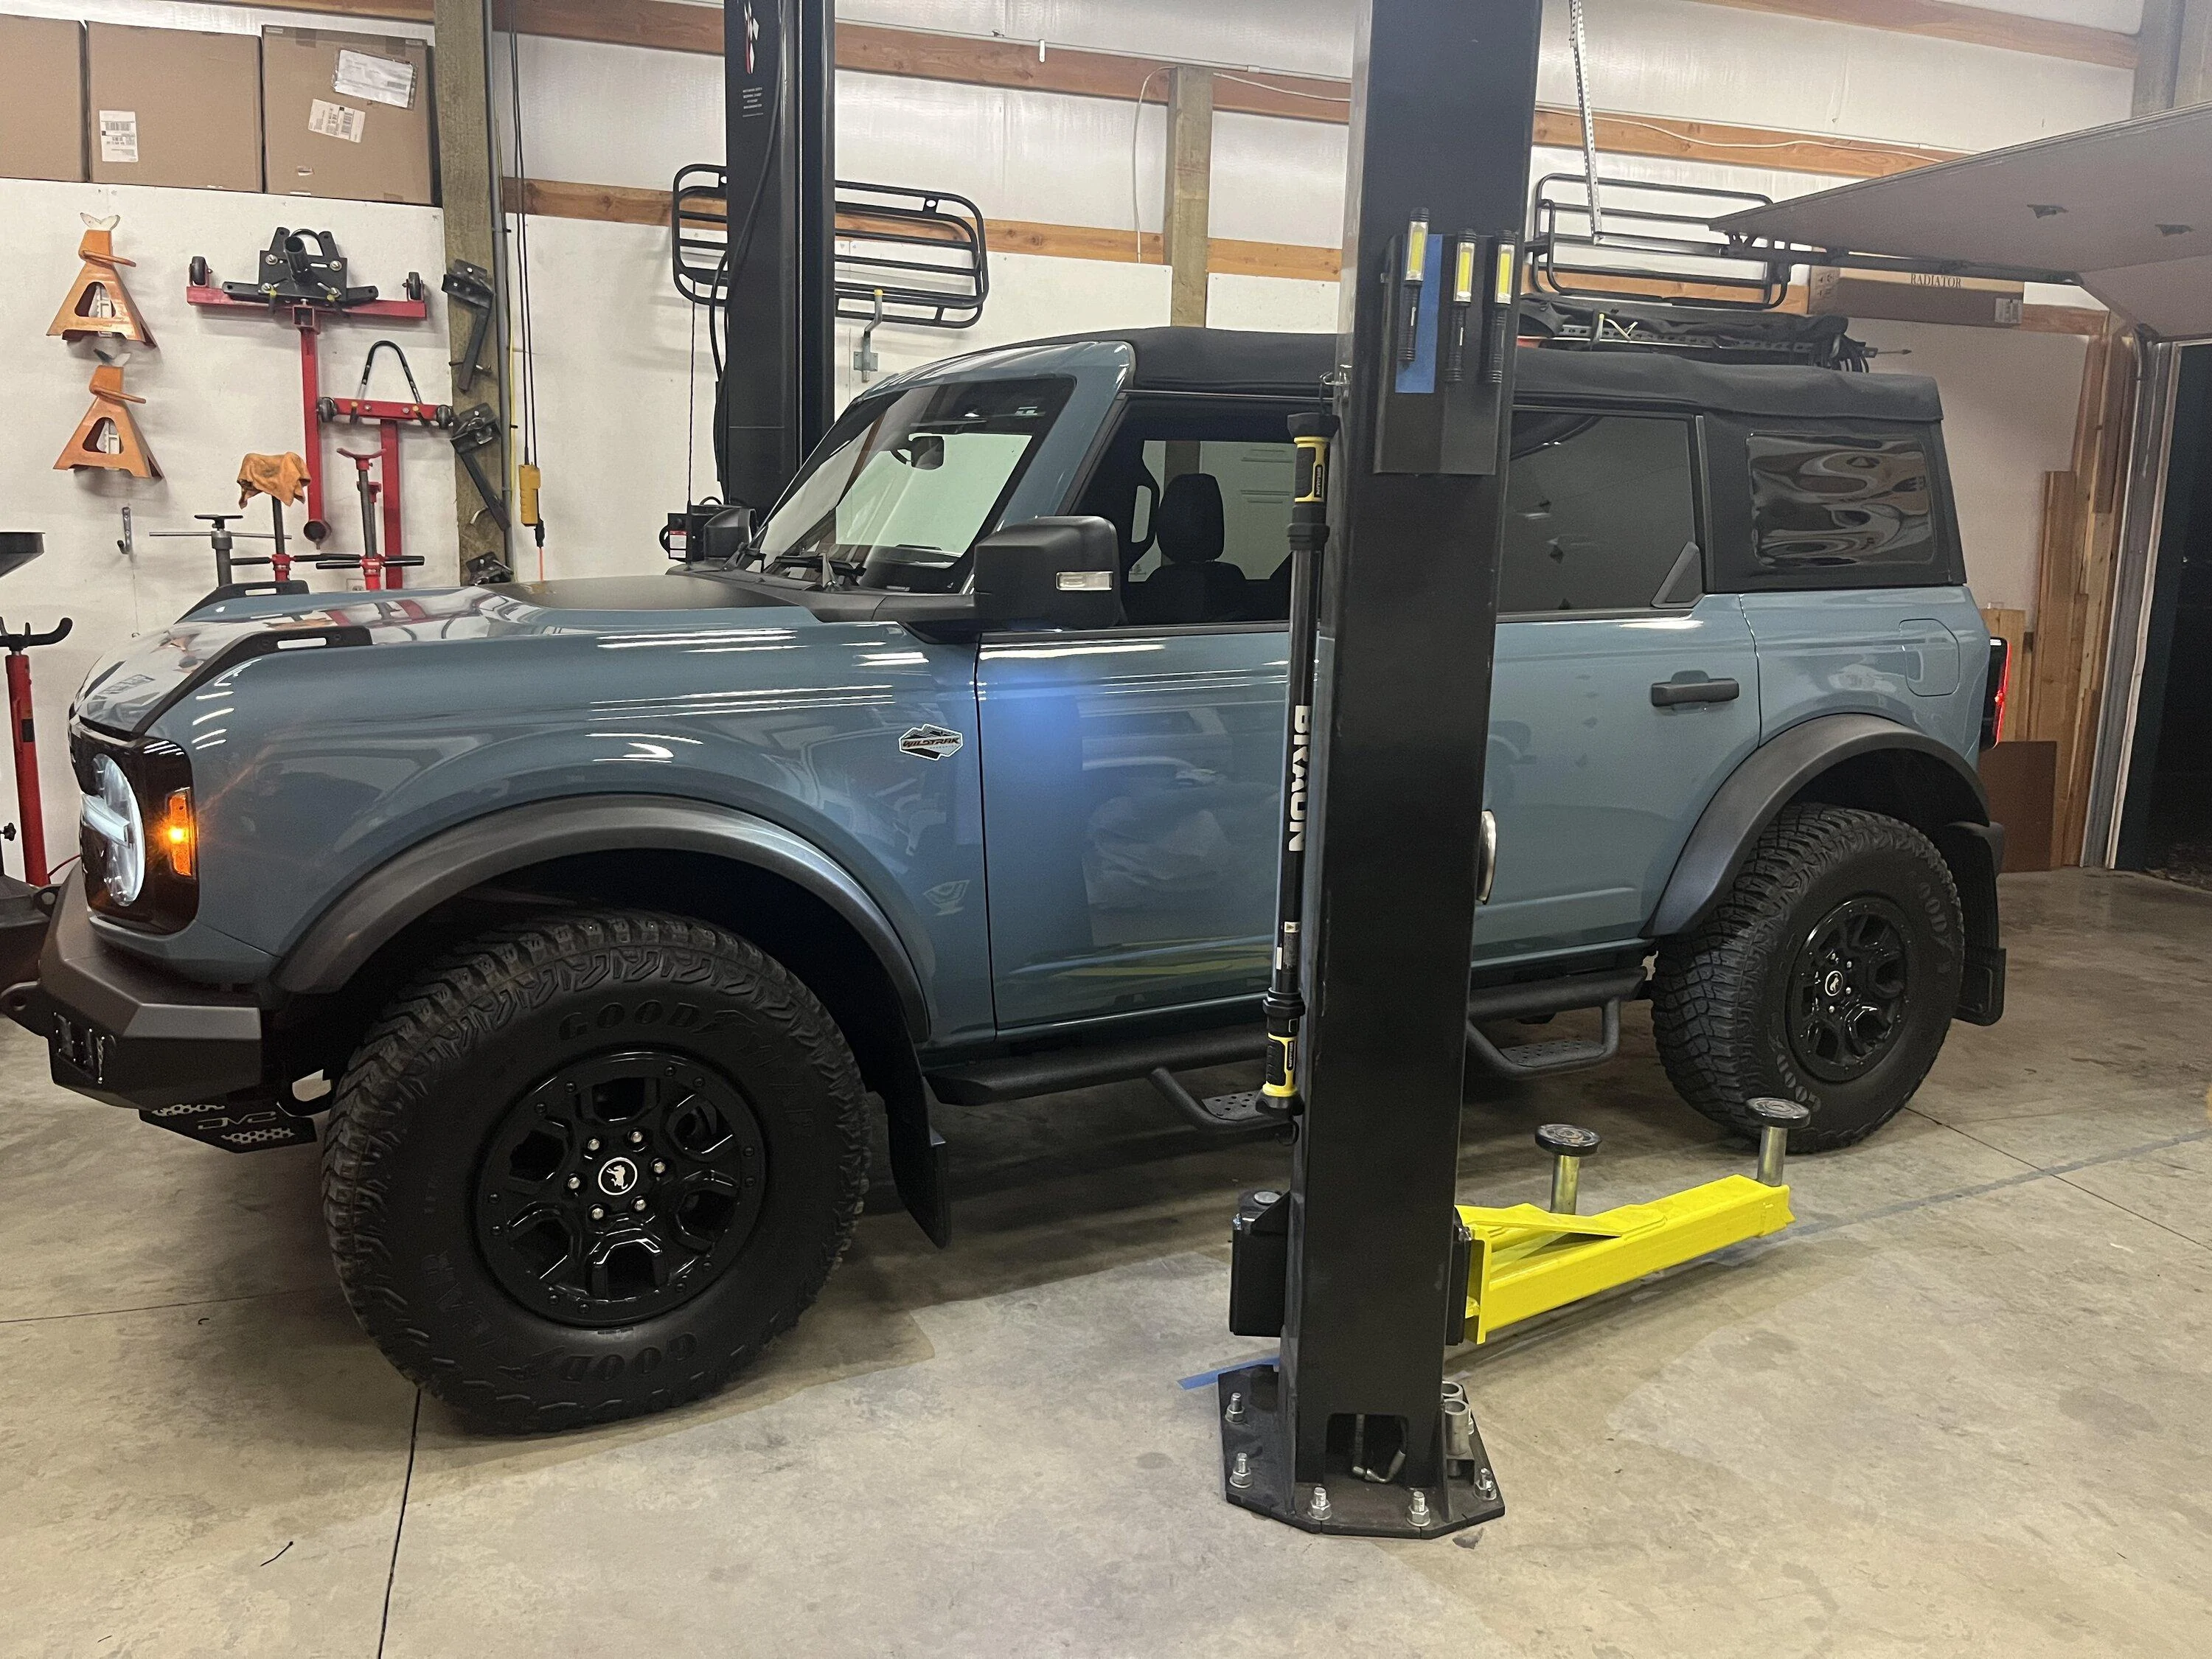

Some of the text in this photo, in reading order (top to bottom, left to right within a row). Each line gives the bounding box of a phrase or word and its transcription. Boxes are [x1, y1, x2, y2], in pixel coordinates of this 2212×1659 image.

[1910, 274, 1961, 288] RADIATOR
[902, 738, 959, 748] WILDTRAK
[1289, 705, 1311, 851] BRAUN
